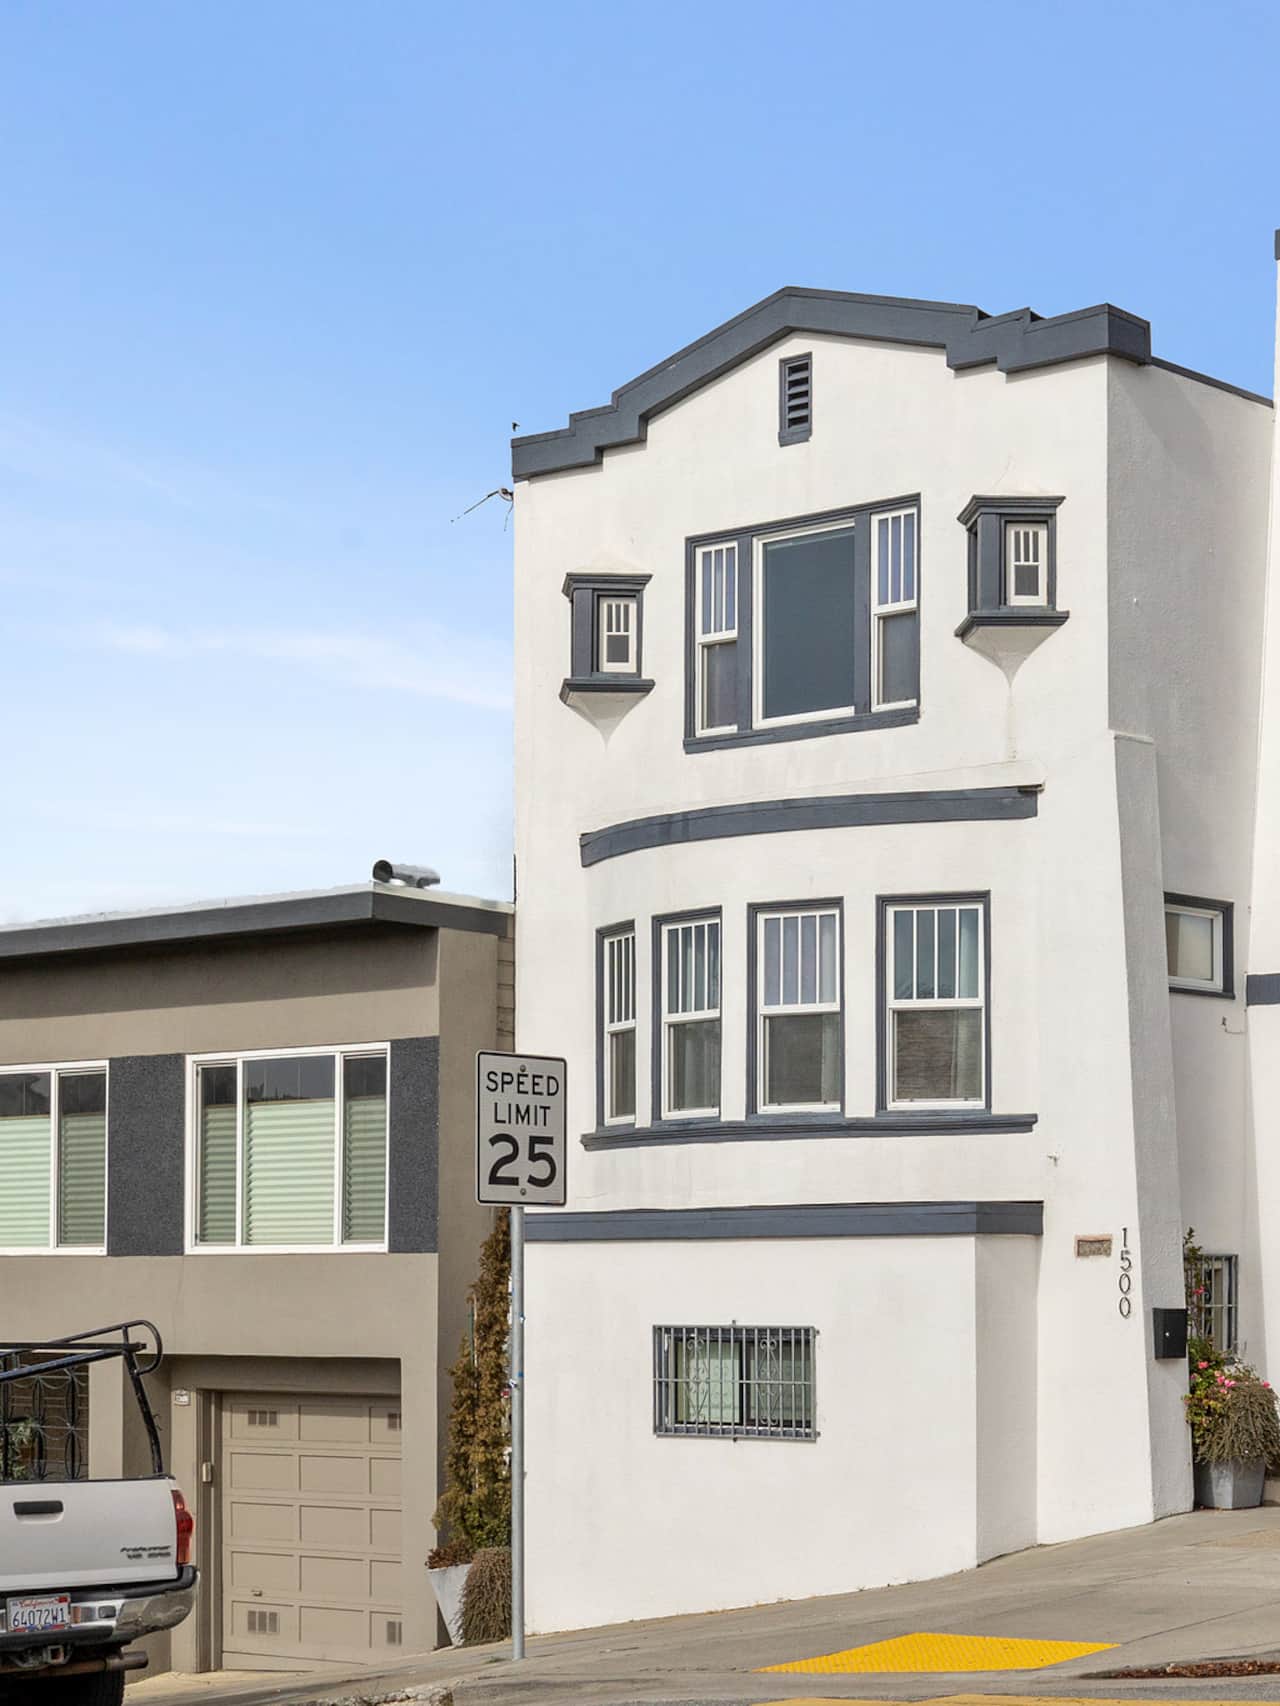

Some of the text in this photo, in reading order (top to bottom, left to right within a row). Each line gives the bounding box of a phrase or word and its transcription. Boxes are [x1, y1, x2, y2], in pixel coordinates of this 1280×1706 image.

[486, 1071, 559, 1096] SPEED
[494, 1102, 551, 1126] LIMIT
[488, 1133, 557, 1188] 25
[1119, 1228, 1132, 1319] 1500
